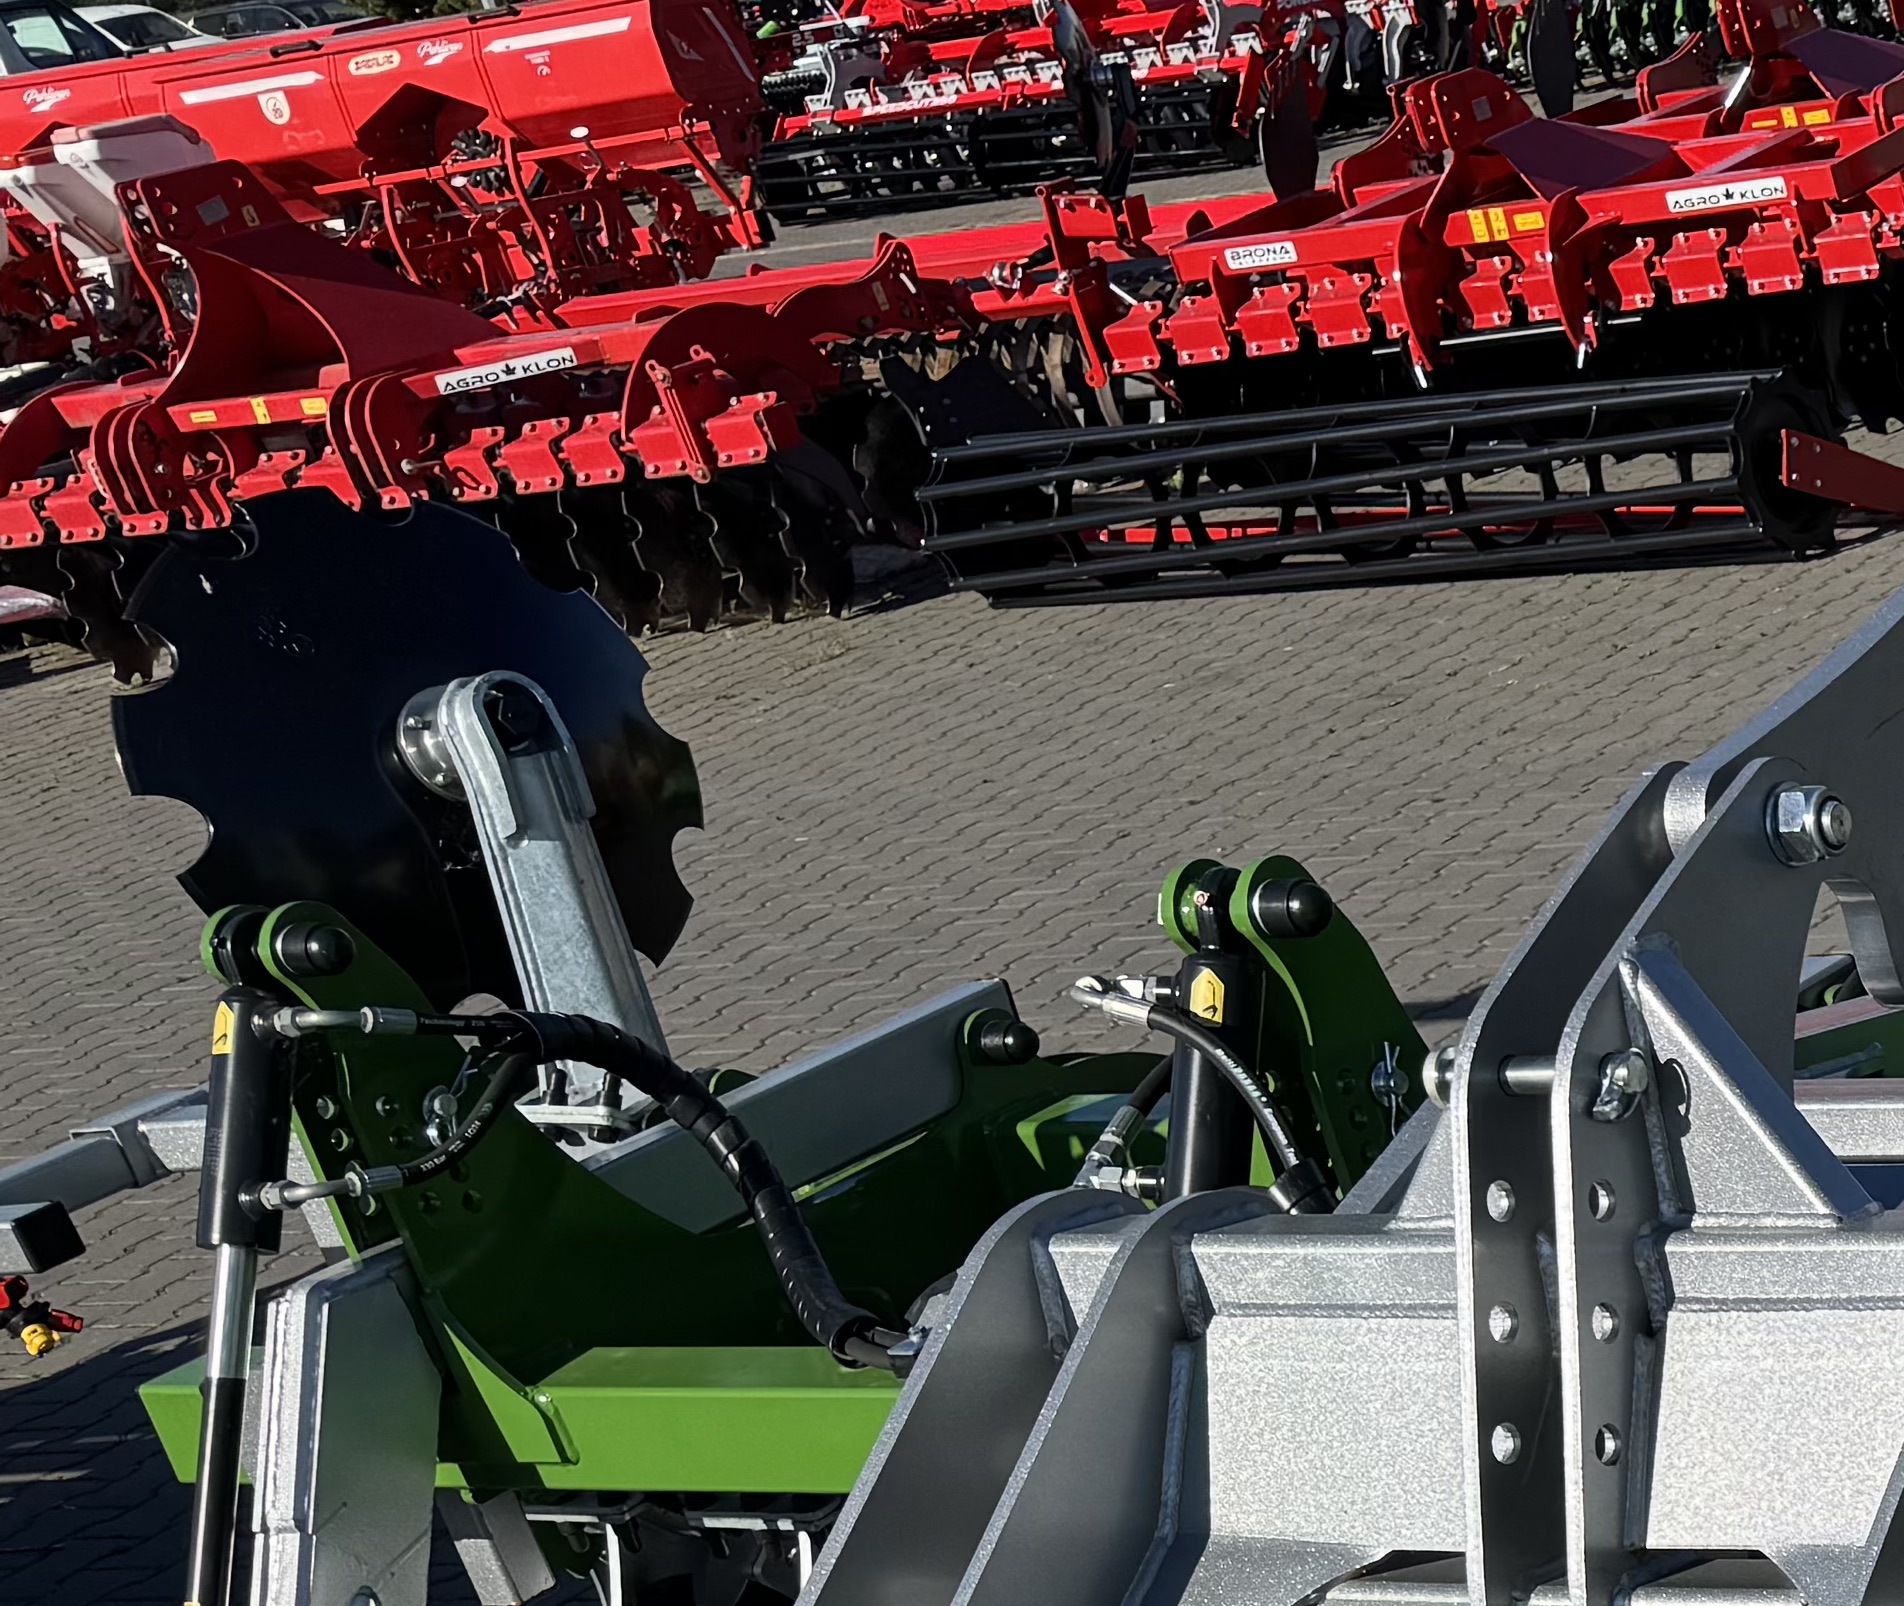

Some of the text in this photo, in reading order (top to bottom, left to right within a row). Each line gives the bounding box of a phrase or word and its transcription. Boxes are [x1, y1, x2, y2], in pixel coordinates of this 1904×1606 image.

[1673, 186, 1784, 209] AGRO KLON
[1230, 245, 1290, 261] BRONA
[443, 355, 575, 393] AGRO KLON
